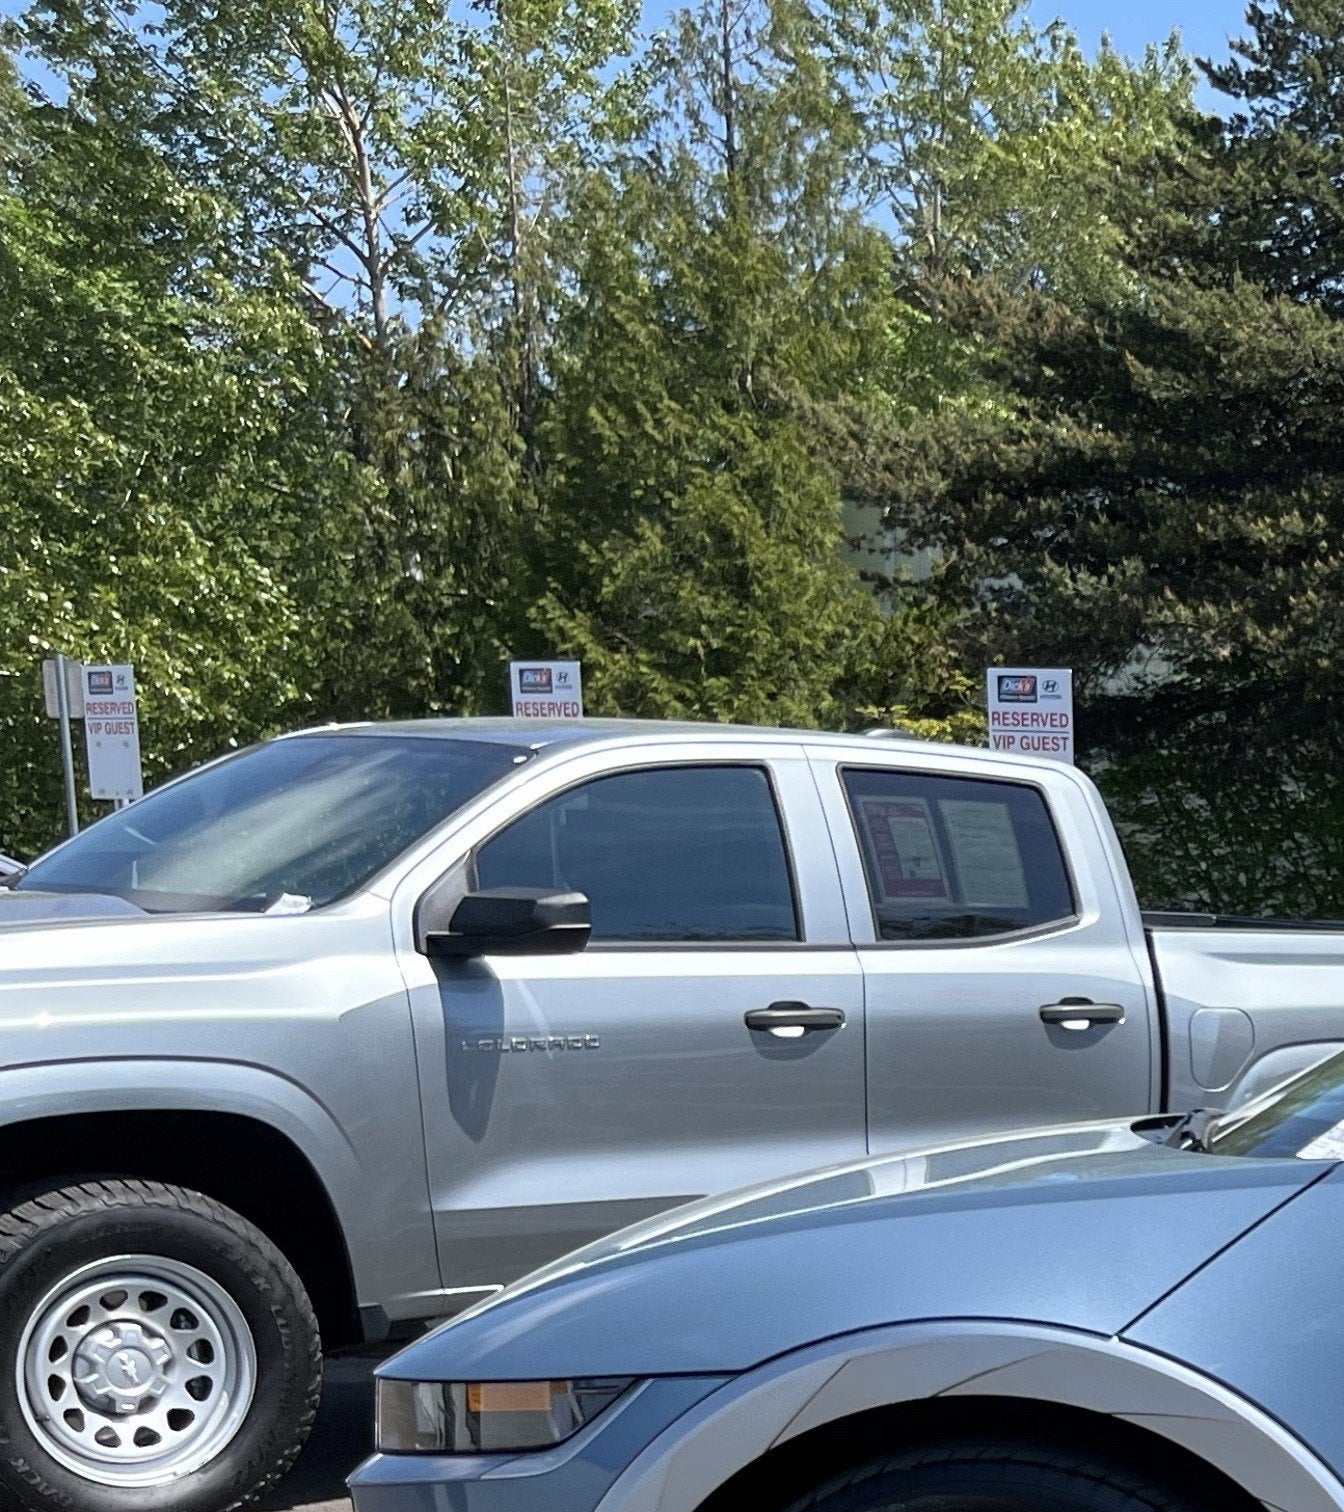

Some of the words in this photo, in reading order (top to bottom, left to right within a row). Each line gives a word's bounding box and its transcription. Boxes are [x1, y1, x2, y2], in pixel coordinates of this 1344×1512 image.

[86, 701, 134, 715] RESERVED
[515, 701, 580, 717] RESERVED
[991, 710, 1069, 728] RESERVED
[88, 721, 103, 735] VIP
[104, 721, 135, 735] GUEST
[992, 734, 1016, 751] VIP
[1020, 734, 1070, 752] GUEST
